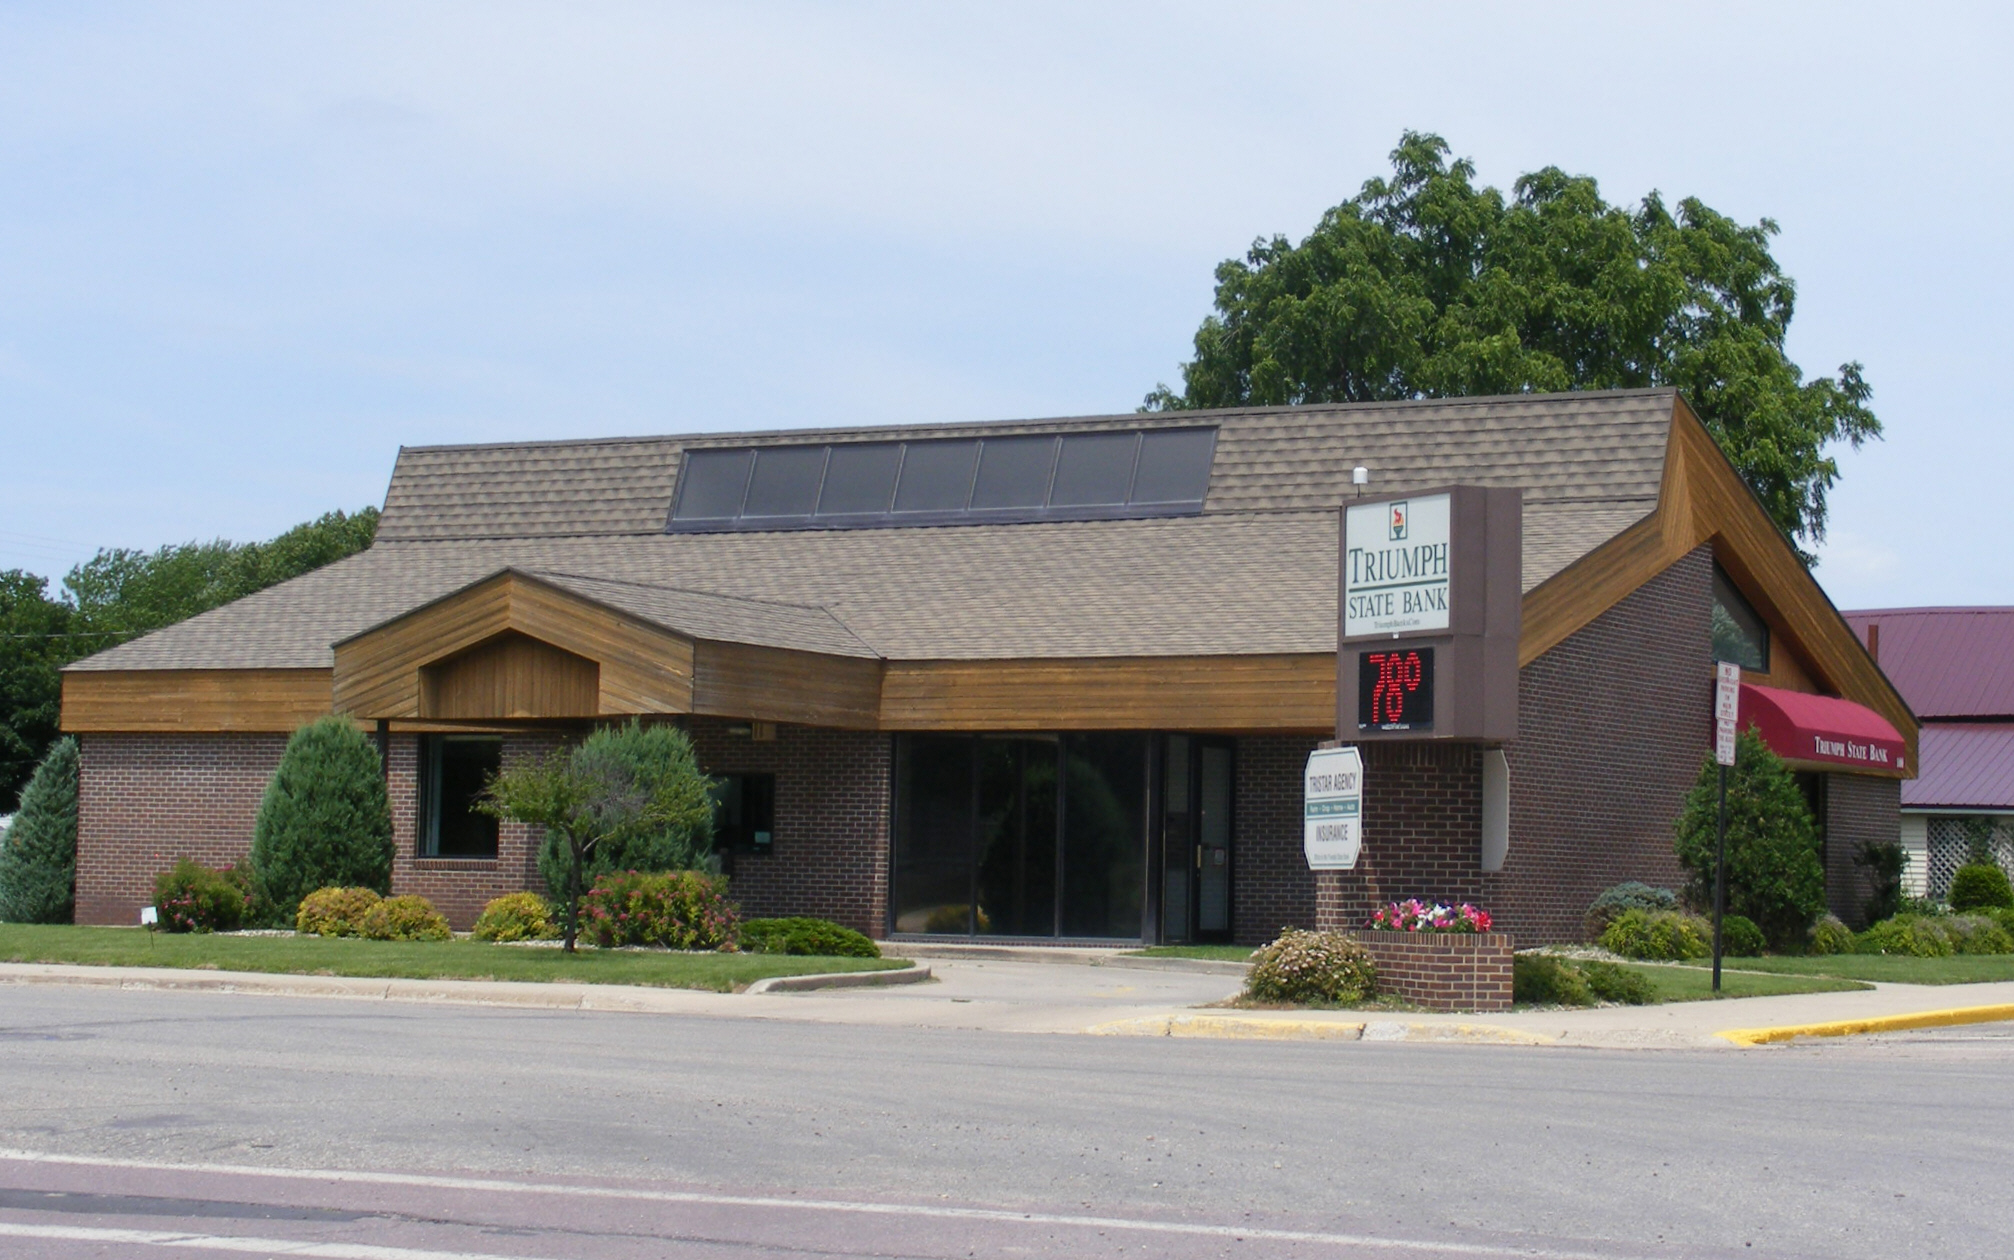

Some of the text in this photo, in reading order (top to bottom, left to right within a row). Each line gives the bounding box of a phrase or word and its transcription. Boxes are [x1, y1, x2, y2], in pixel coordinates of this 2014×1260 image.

[1349, 543, 1448, 583] TRIUMPH
[1349, 588, 1448, 619] STATE BANK
[1814, 736, 1888, 763] TRIUMPH STATE BANK
[1310, 772, 1357, 792] TRISTAR AGENCY
[1316, 824, 1349, 842] INSURANCE
